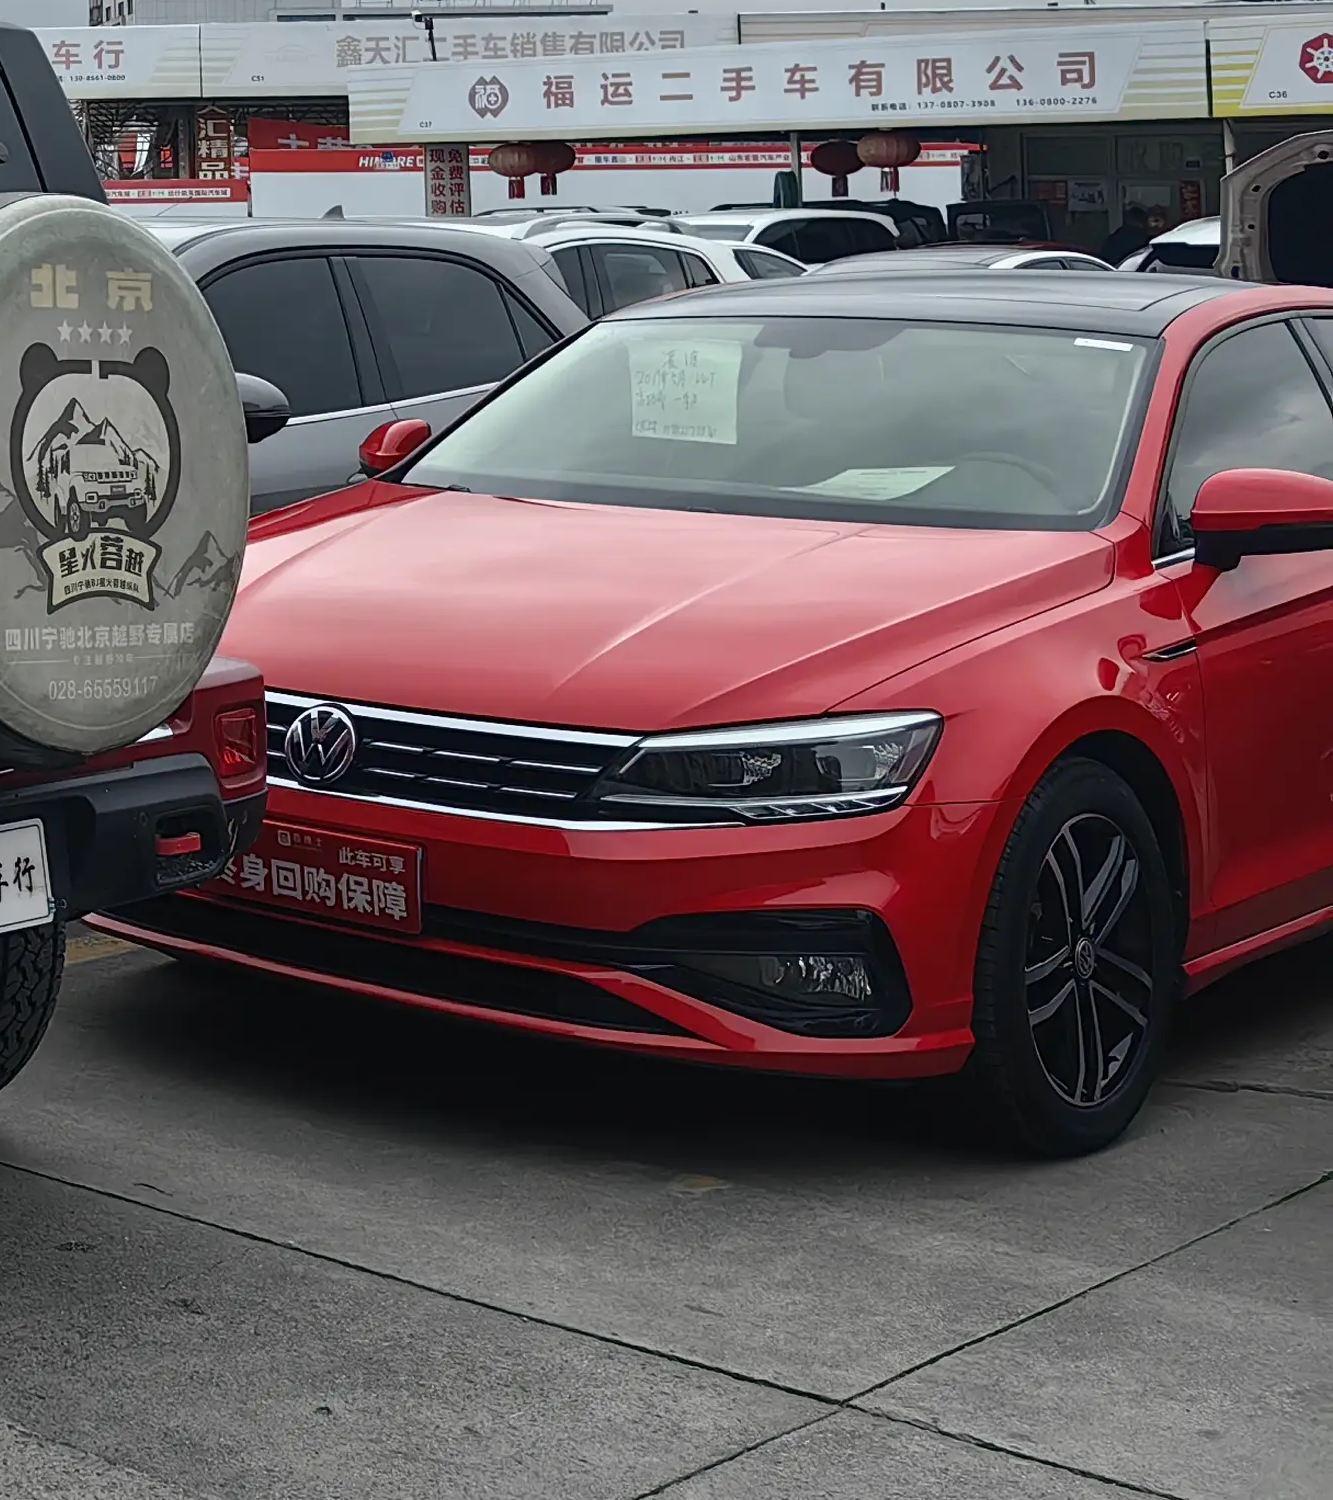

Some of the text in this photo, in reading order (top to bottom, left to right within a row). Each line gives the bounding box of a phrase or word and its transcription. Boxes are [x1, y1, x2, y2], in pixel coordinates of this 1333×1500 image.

[51, 40, 125, 70] 车行
[336, 30, 685, 67] 鑫天汇二手车销售有限公司
[542, 51, 1097, 109] 福运二手车有限公司
[429, 149, 447, 214] 现金收购
[448, 148, 466, 214] 免费评估
[30, 263, 153, 311] 北京
[4, 622, 196, 651] 四川宁驰北京越野专属店
[48, 676, 159, 701] 028-65559117
[338, 846, 406, 874] 此车可享
